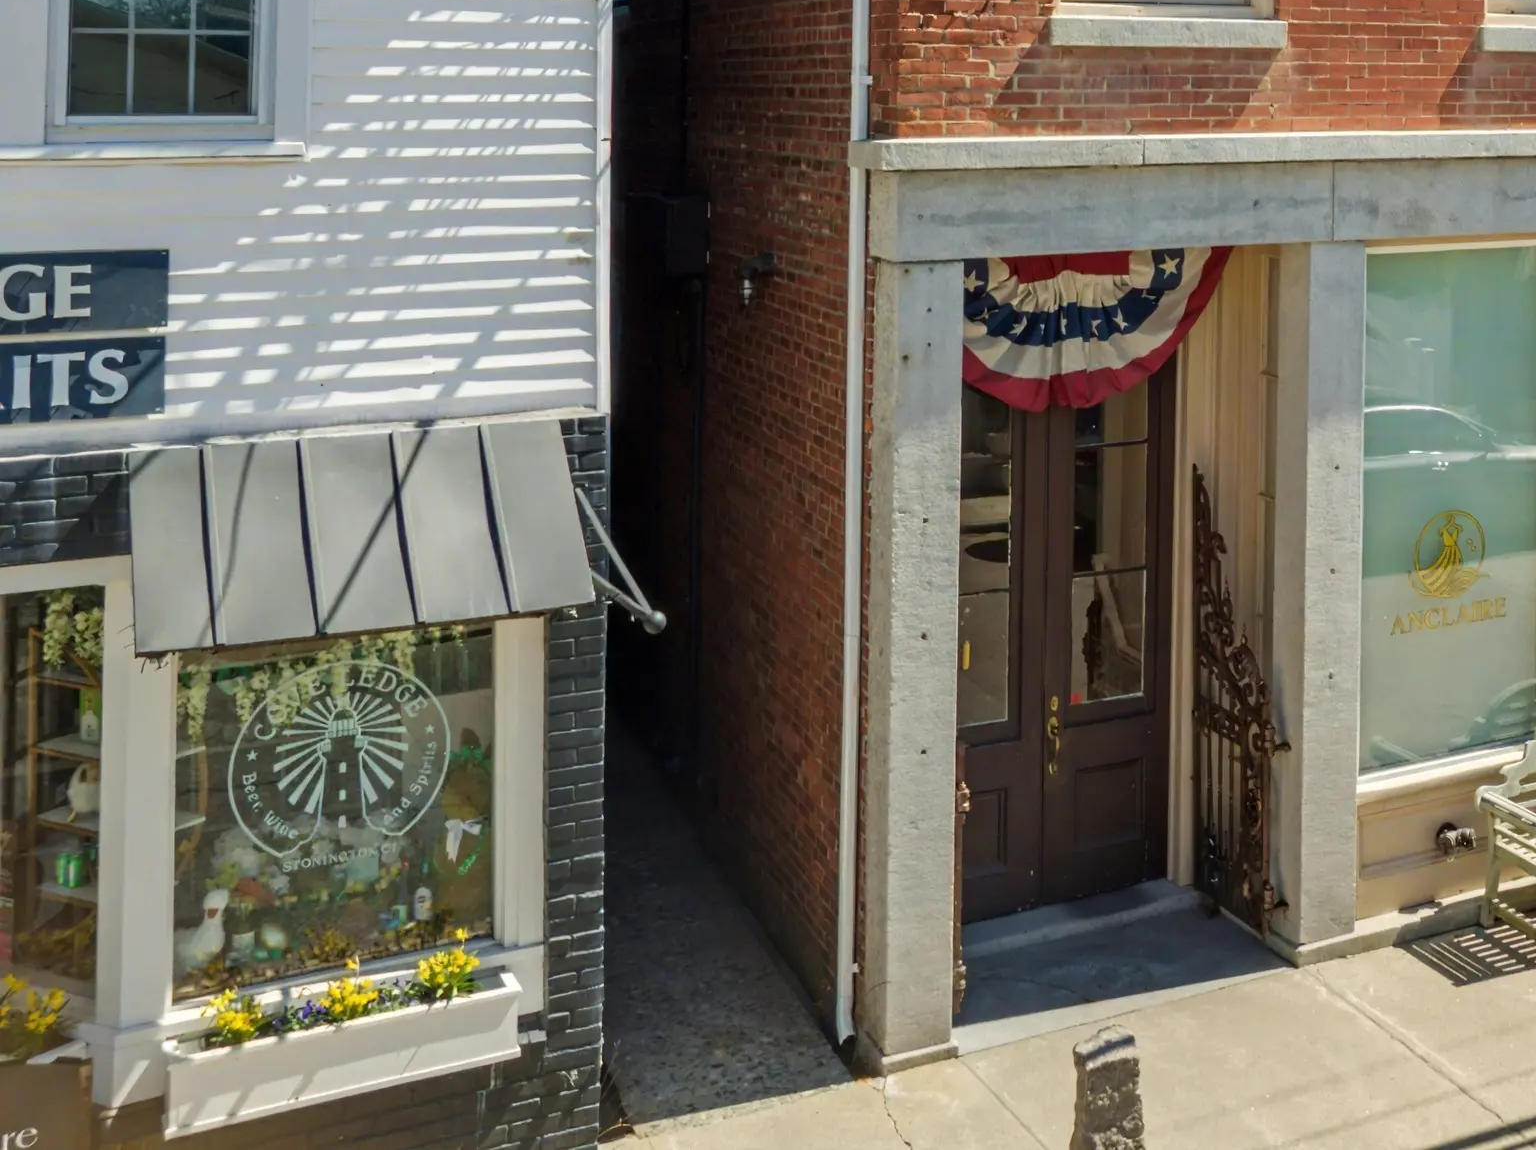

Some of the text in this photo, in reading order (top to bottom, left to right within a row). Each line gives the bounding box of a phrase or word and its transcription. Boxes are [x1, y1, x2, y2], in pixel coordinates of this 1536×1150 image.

[0, 348, 129, 409] ITS
[1390, 597, 1507, 635] ANCLAIRE
[340, 665, 428, 718] LEDGE
[263, 810, 299, 839] Wine
